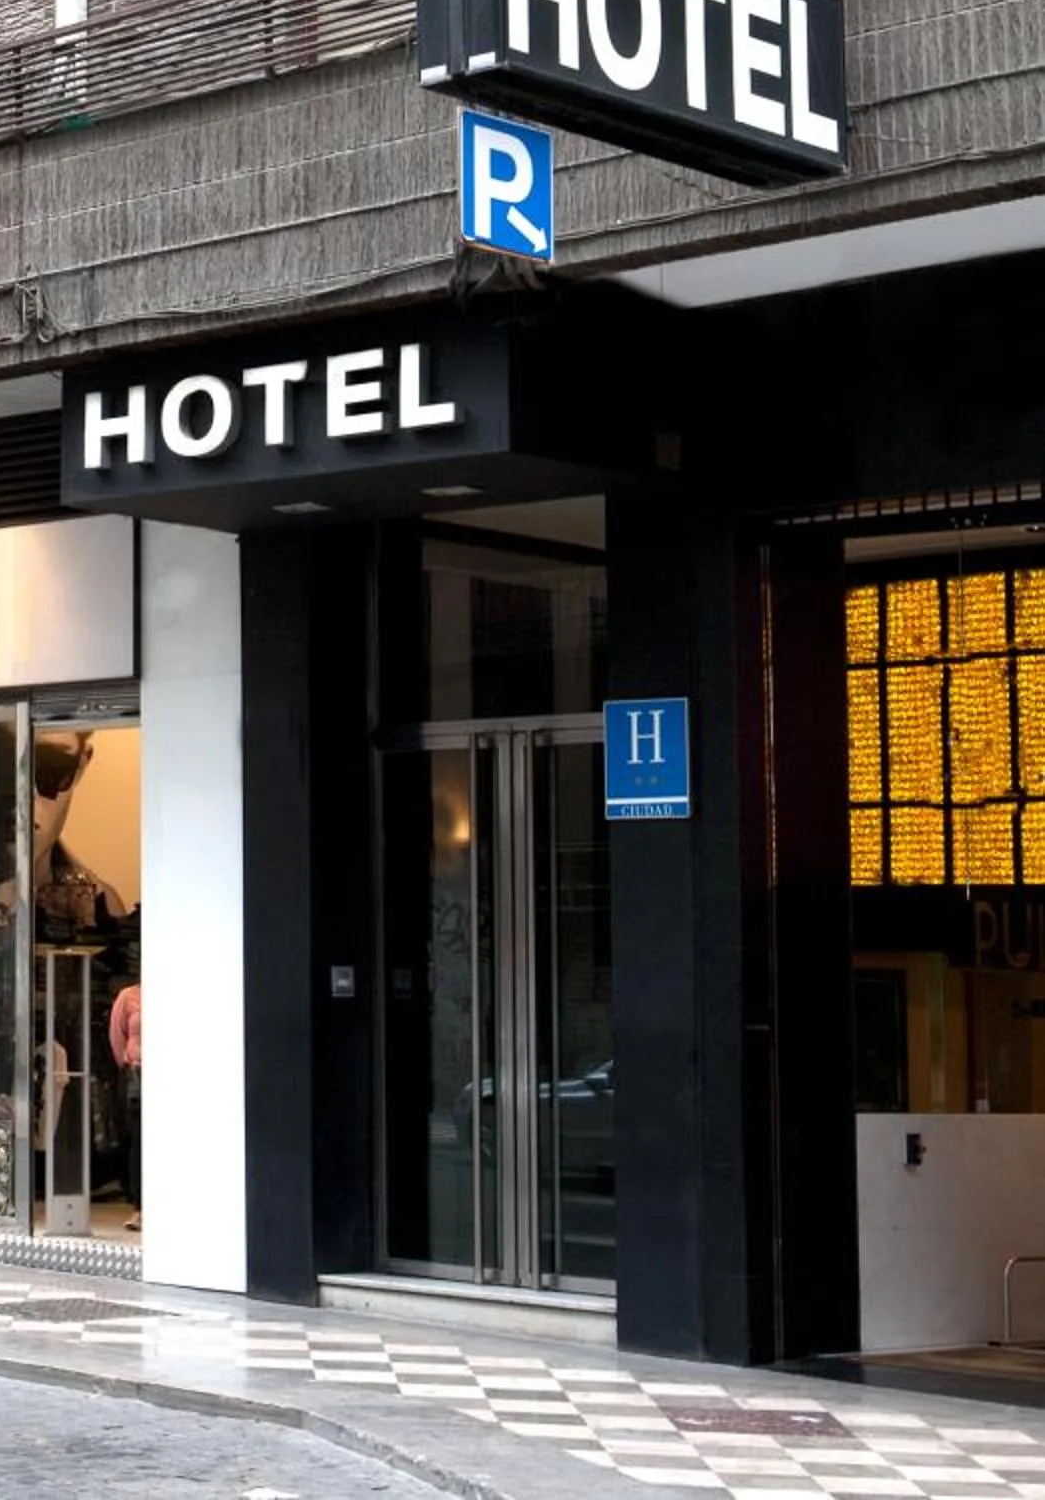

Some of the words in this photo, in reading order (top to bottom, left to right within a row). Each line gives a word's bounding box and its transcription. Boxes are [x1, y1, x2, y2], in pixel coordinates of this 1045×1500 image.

[473, 125, 534, 239] P
[84, 343, 457, 469] HOTEL
[626, 709, 666, 765] H
[620, 804, 674, 817] CIUDAD
